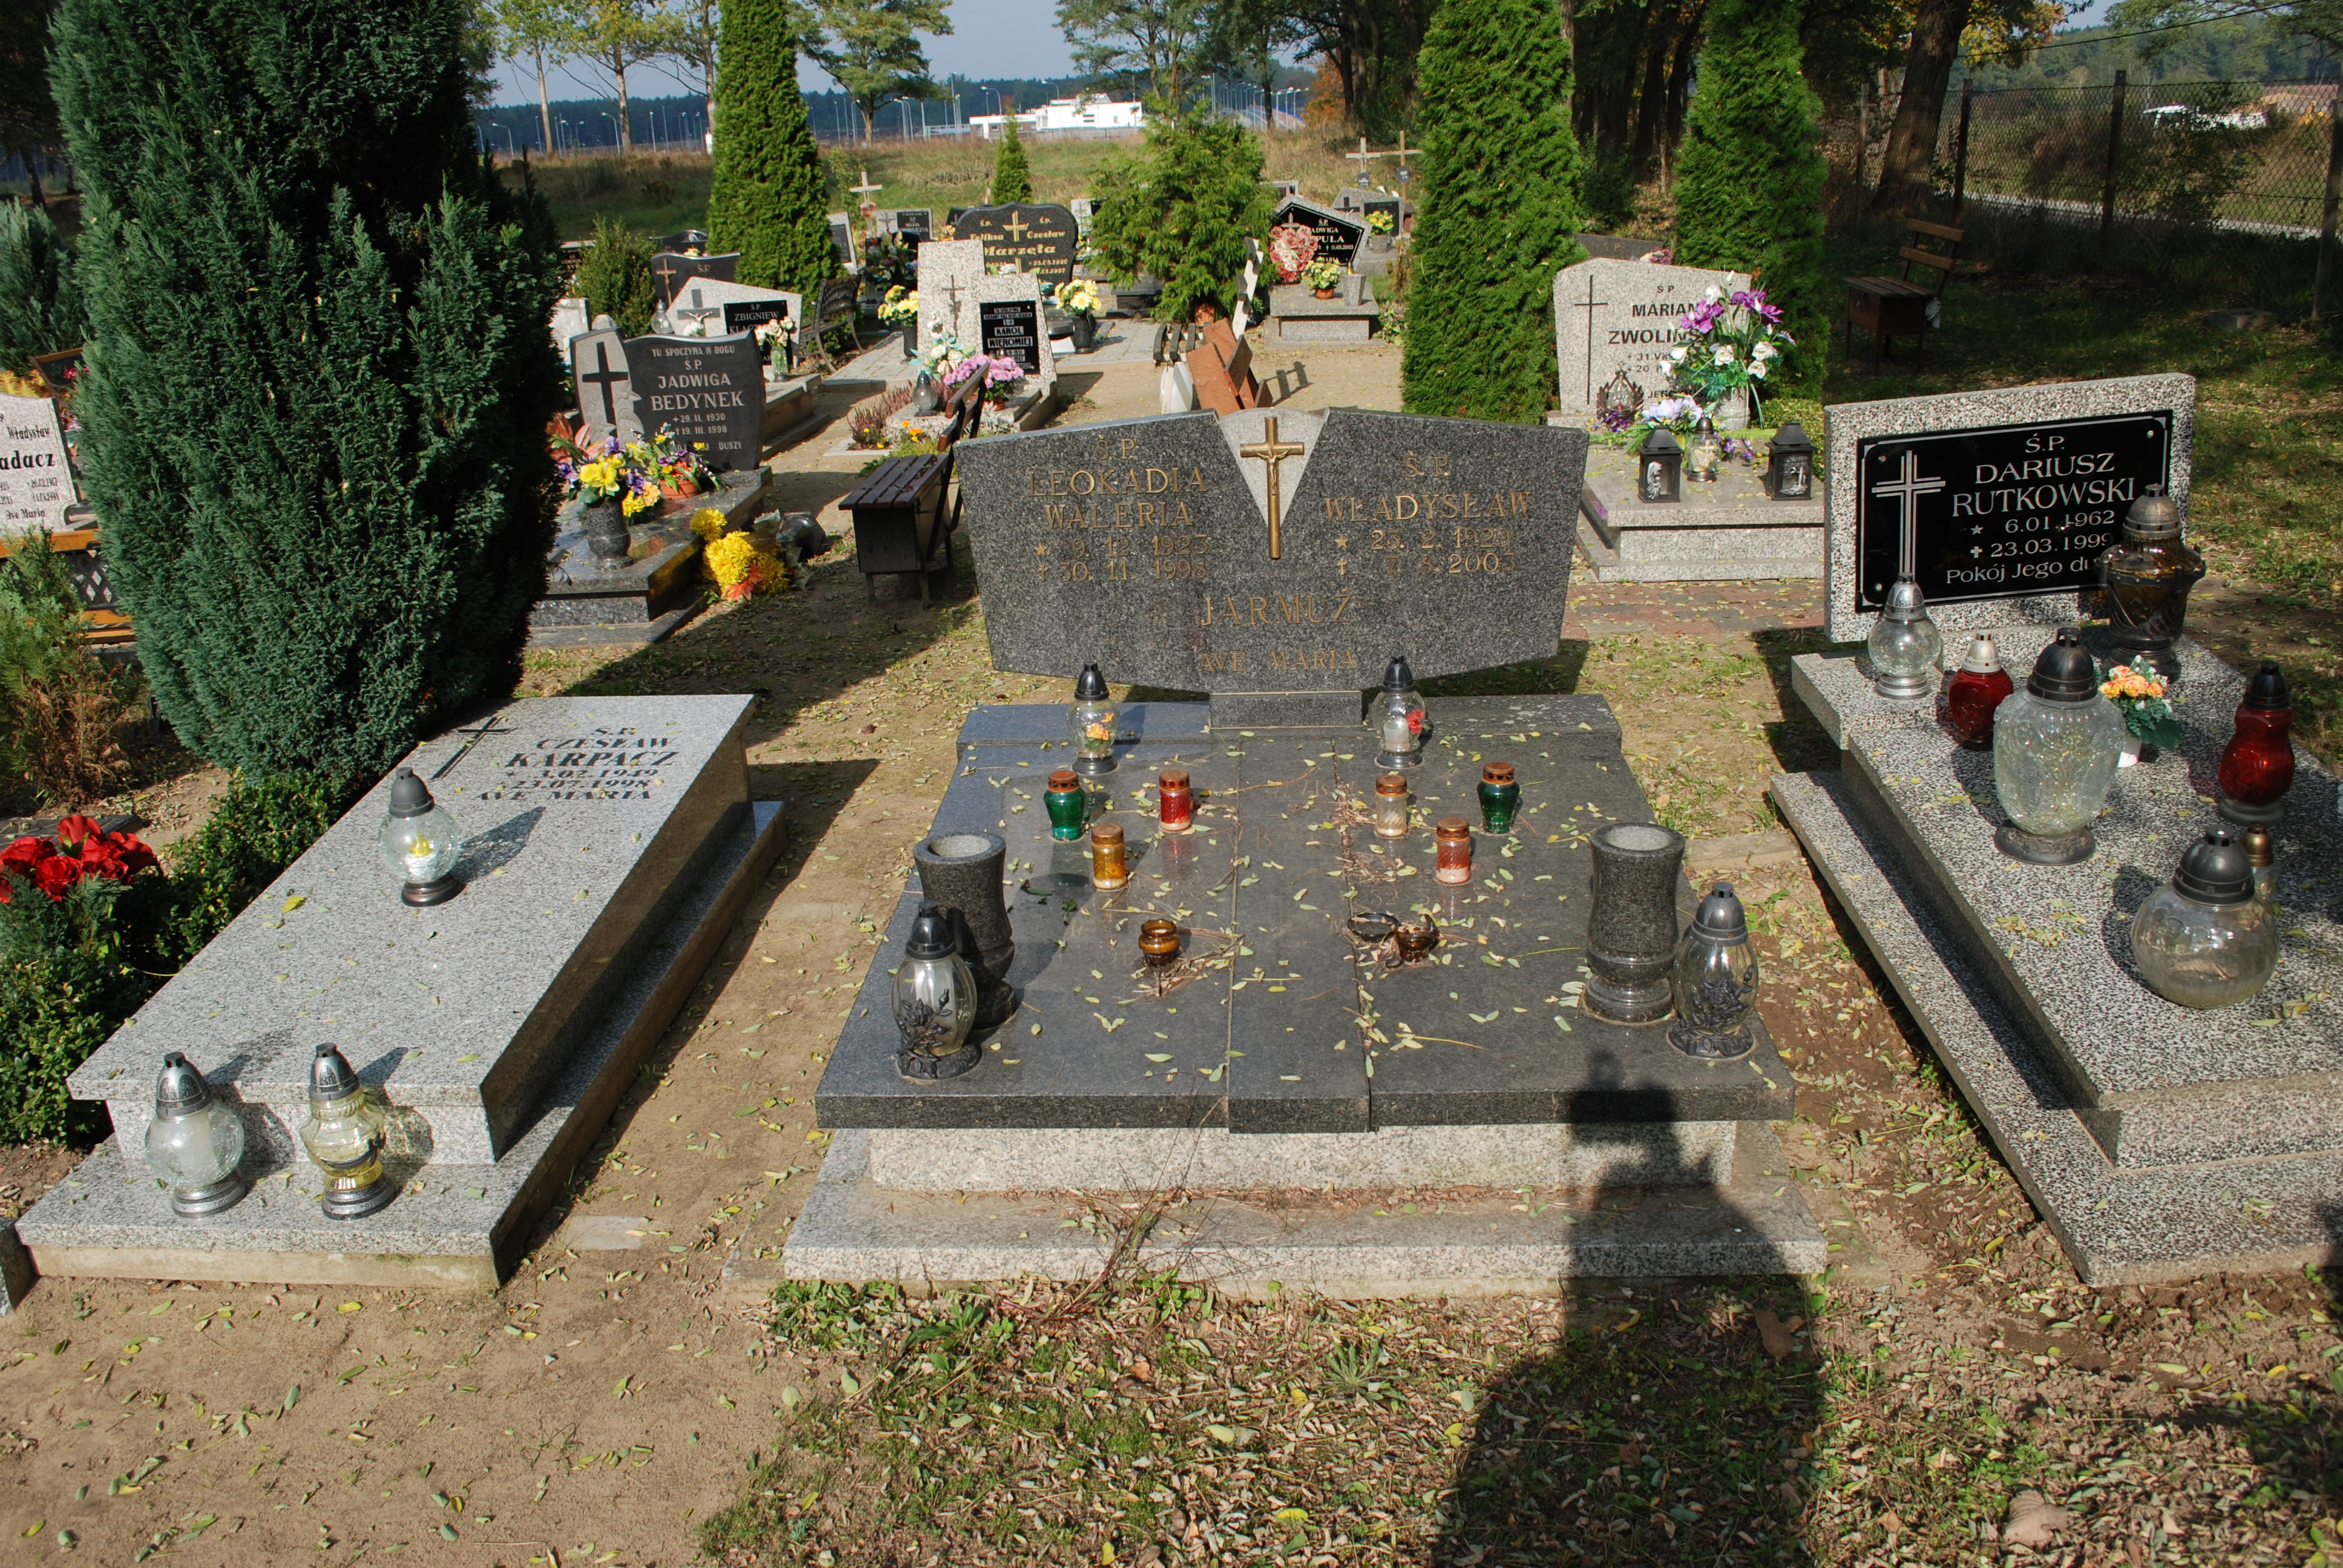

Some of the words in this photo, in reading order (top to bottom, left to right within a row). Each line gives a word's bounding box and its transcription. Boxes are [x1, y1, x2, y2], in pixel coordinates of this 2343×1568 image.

[734, 311, 779, 321] ZBIGNIEW
[996, 327, 1022, 336] KAROL
[989, 337, 1031, 347] WIEROMIEJ
[652, 348, 661, 358] TU
[666, 347, 703, 357] SPOCZYWA
[706, 347, 712, 355] W
[715, 345, 735, 354] BOGU
[657, 373, 731, 390] JADWIGA
[650, 390, 745, 411] BEDYNEK
[706, 413, 726, 422] 1930
[708, 425, 727, 434] 1998
[718, 441, 742, 450] DUSZY
[1975, 453, 2115, 485] DARIUSZ
[1029, 466, 1208, 497] LEOKADIA
[1952, 477, 2135, 517] RUTKOWSKI
[1044, 501, 1193, 529] WALERIA
[1324, 492, 1531, 522] WŁADYSŁAW
[1152, 534, 1208, 556] 1923
[1453, 526, 1512, 548] 1929
[1154, 560, 1208, 580] 1998
[1946, 564, 2005, 584] Pokój
[2011, 561, 2063, 579] Jego
[1198, 651, 1247, 672] AVE
[1268, 649, 1356, 670] MARIA
[536, 738, 677, 749] CZESŁAW
[505, 751, 680, 767] KARPACZ
[473, 791, 531, 801] AVE
[548, 791, 650, 800] MARIA
